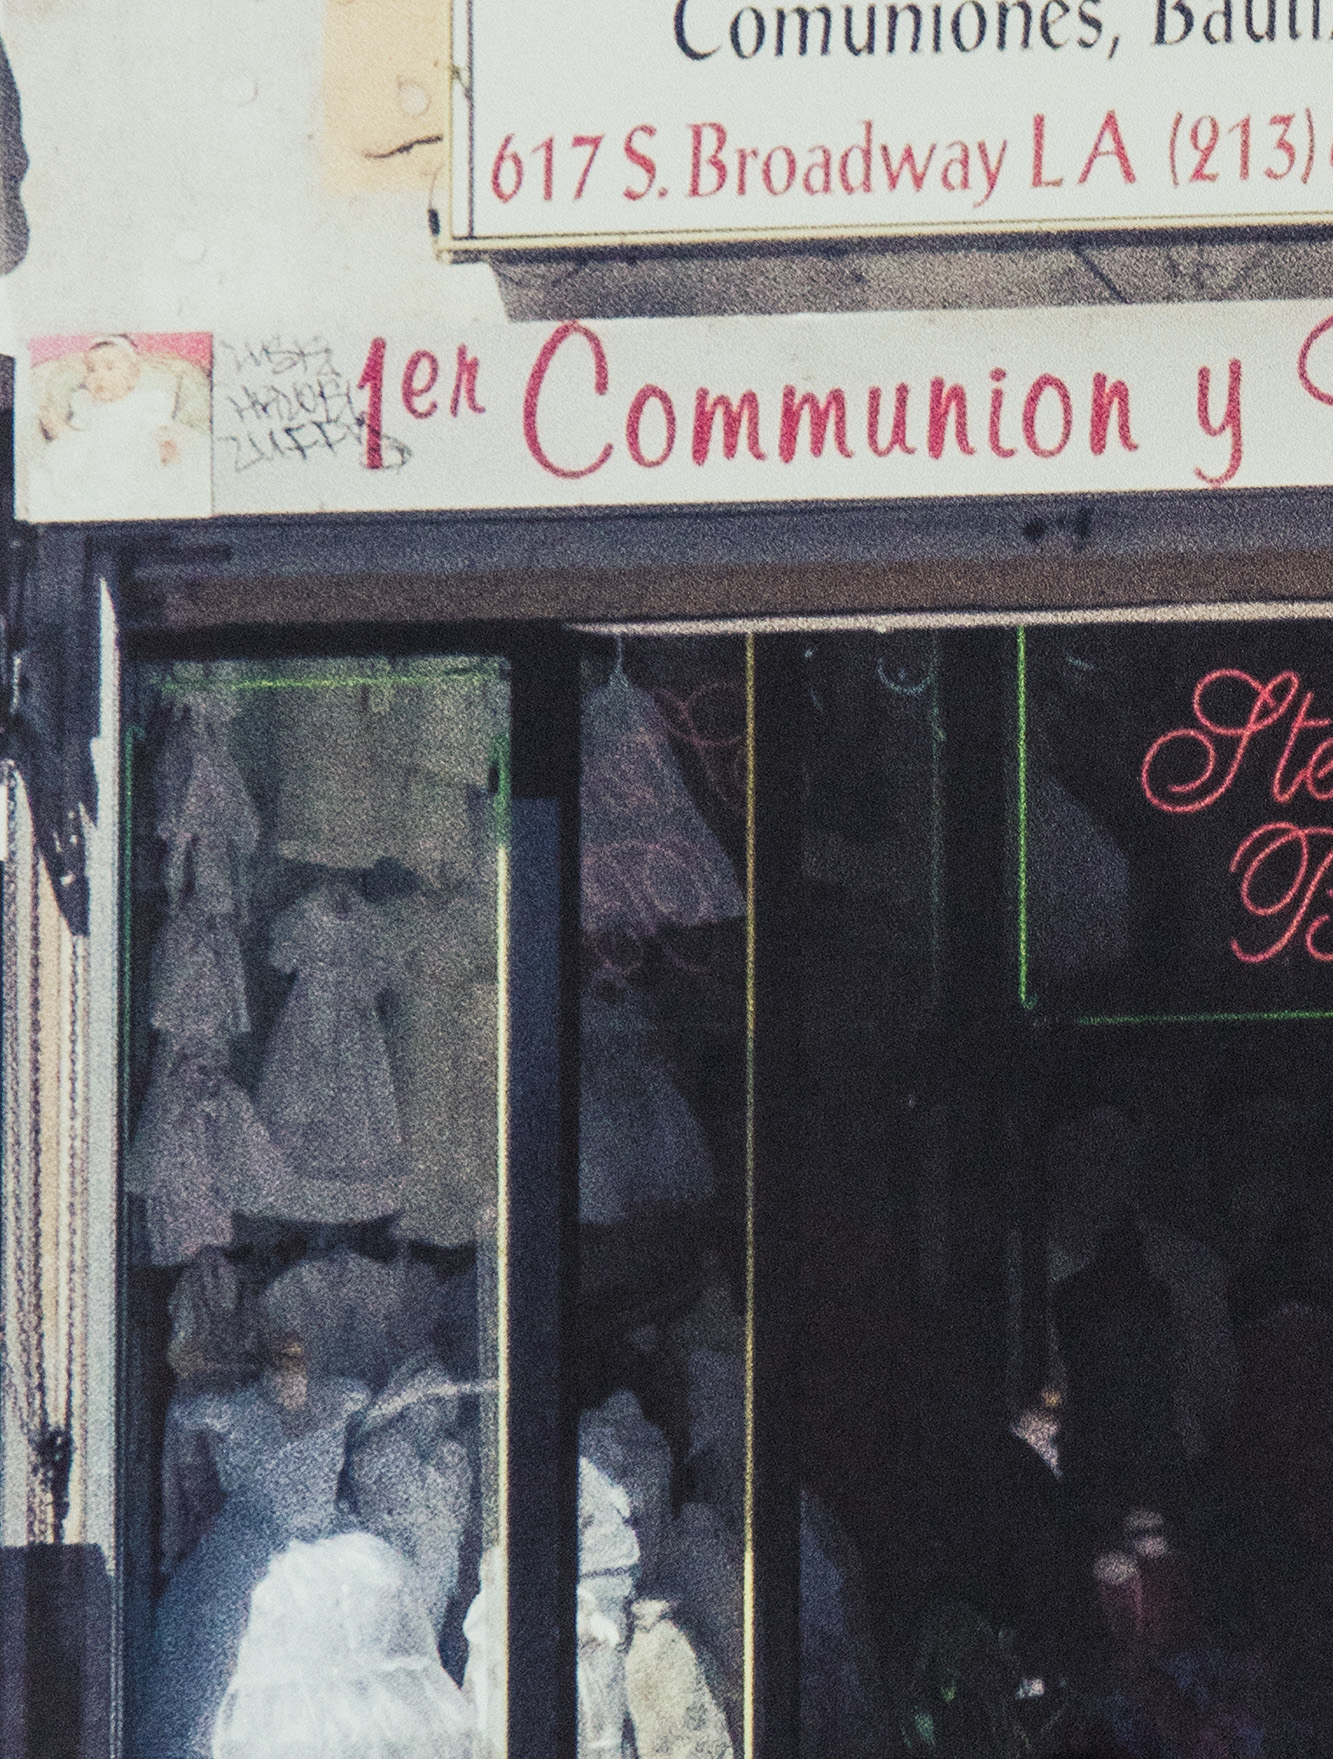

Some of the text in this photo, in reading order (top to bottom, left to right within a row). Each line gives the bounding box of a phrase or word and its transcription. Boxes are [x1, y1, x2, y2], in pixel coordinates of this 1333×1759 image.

[488, 133, 604, 203] 617
[622, 124, 671, 203] S.
[687, 121, 1007, 209] Broadway
[357, 336, 487, 470] 1er
[522, 320, 1140, 479] Communion
[1195, 356, 1243, 488] y
